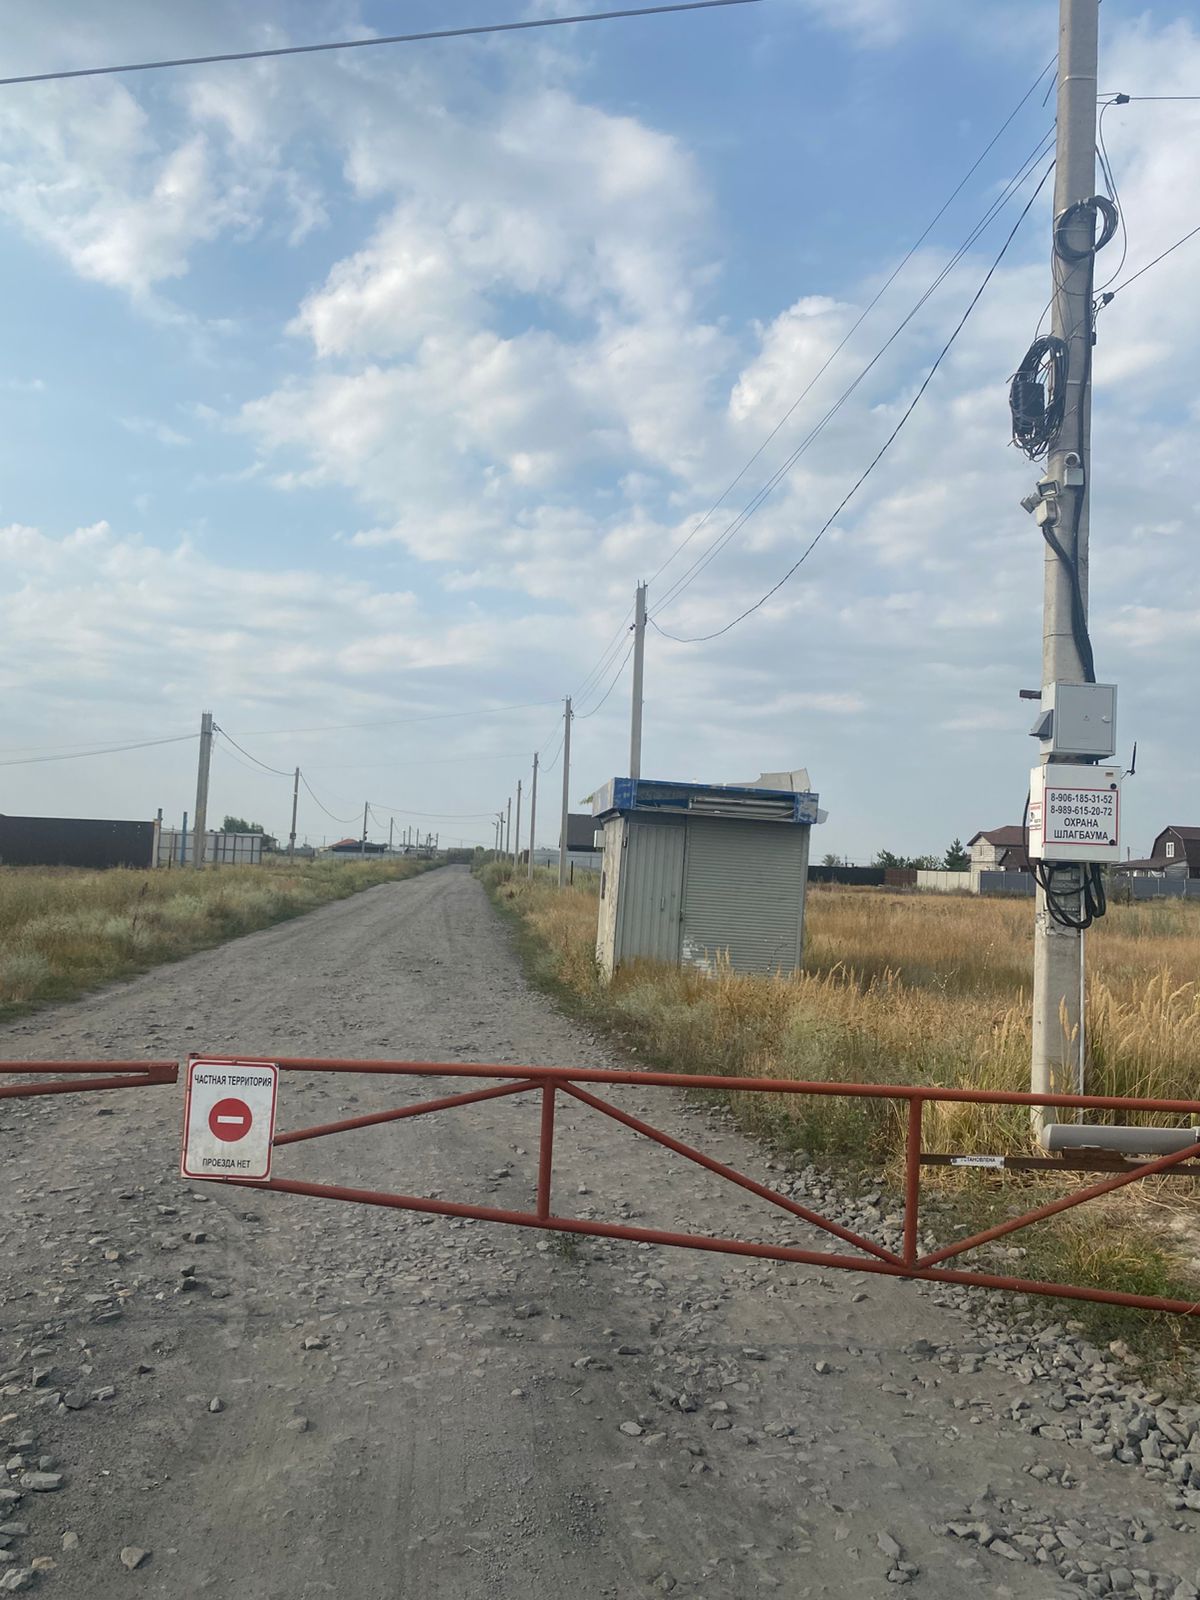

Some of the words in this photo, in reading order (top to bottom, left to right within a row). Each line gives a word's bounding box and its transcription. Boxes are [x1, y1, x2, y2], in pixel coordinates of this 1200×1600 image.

[1050, 793, 1113, 804] 8-906-185-31-52
[1050, 805, 1113, 816] 8-989-615-20-72
[1064, 817, 1099, 828] ОХРАНА
[1054, 830, 1109, 840] ШЛАГБАУМА
[194, 1074, 226, 1085] ЧАСТНАЯ
[228, 1075, 272, 1087] ТЕРРИТОРИЯ
[202, 1158, 235, 1168] ПРОЕЗДА
[236, 1159, 251, 1168] НЕТ
